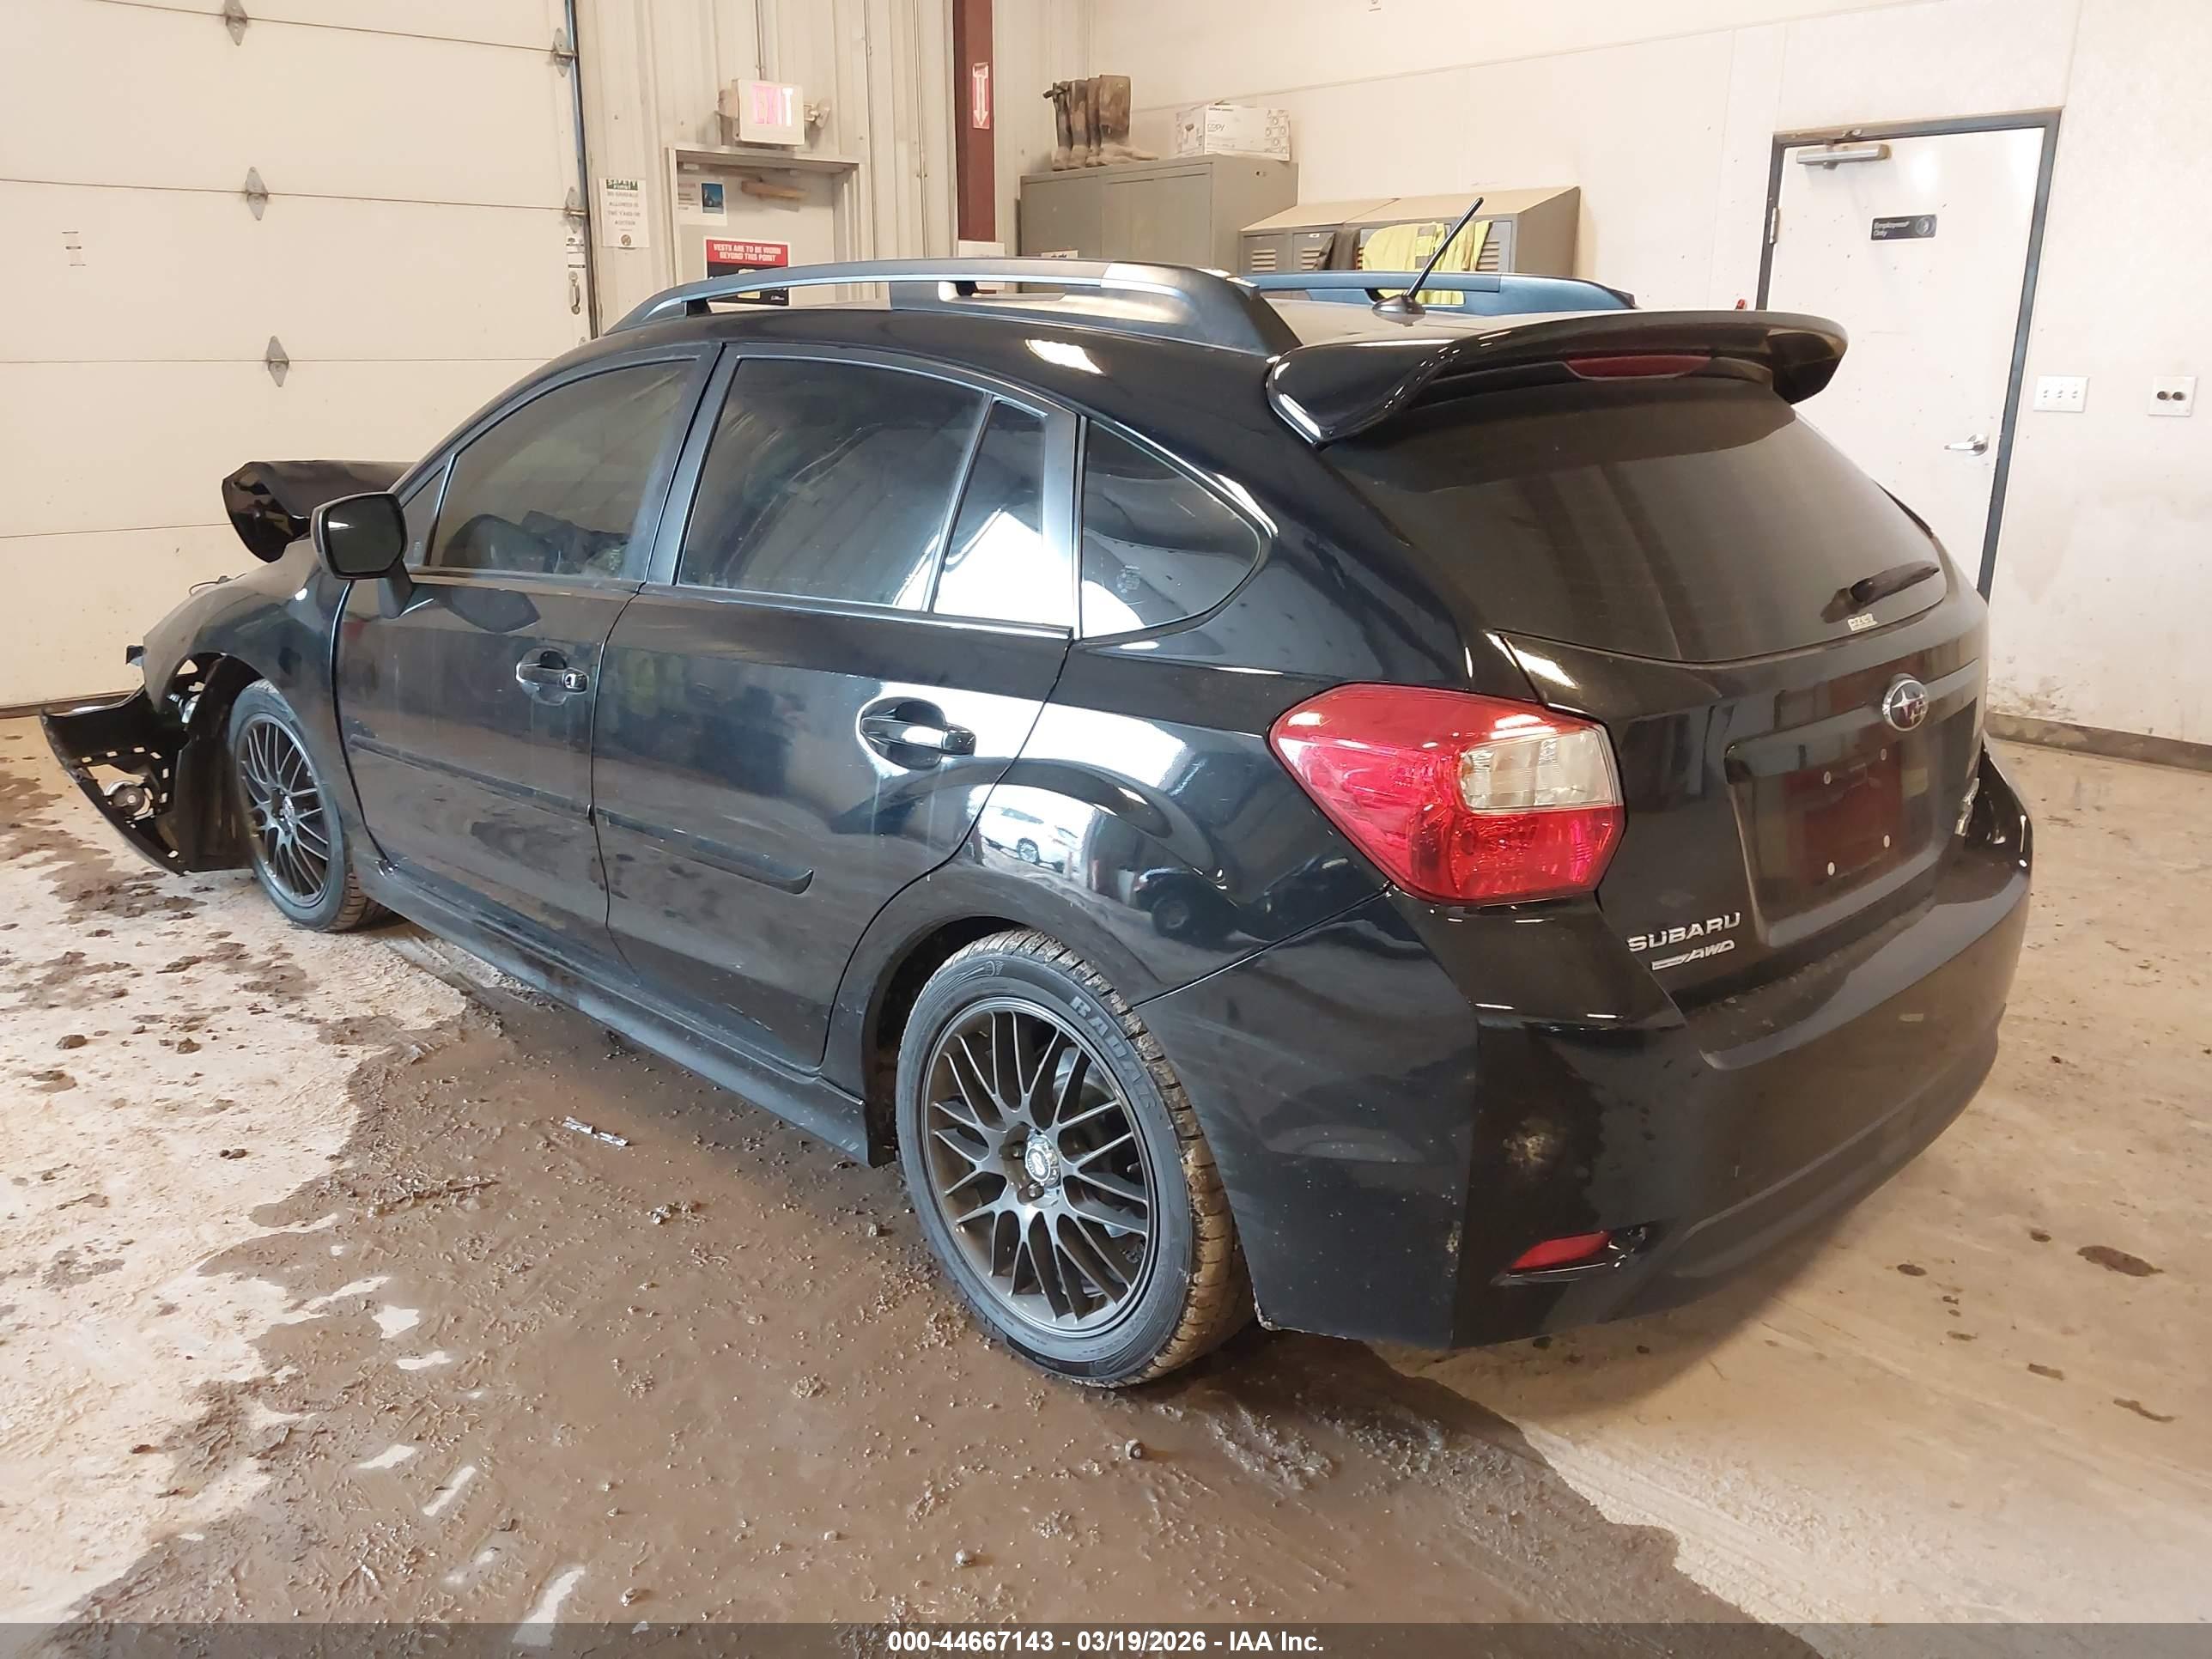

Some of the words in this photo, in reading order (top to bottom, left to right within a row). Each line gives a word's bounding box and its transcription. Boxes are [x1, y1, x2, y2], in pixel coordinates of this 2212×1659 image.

[752, 84, 793, 127] EXIT
[713, 243, 732, 252] VESTS
[732, 244, 744, 252] ARE
[763, 246, 781, 255] WORN
[719, 252, 744, 260] BEYOND
[744, 252, 757, 261] THIS
[758, 253, 776, 262] POINT
[1627, 911, 1741, 952] SUBARU
[1683, 939, 1736, 963] AWD
